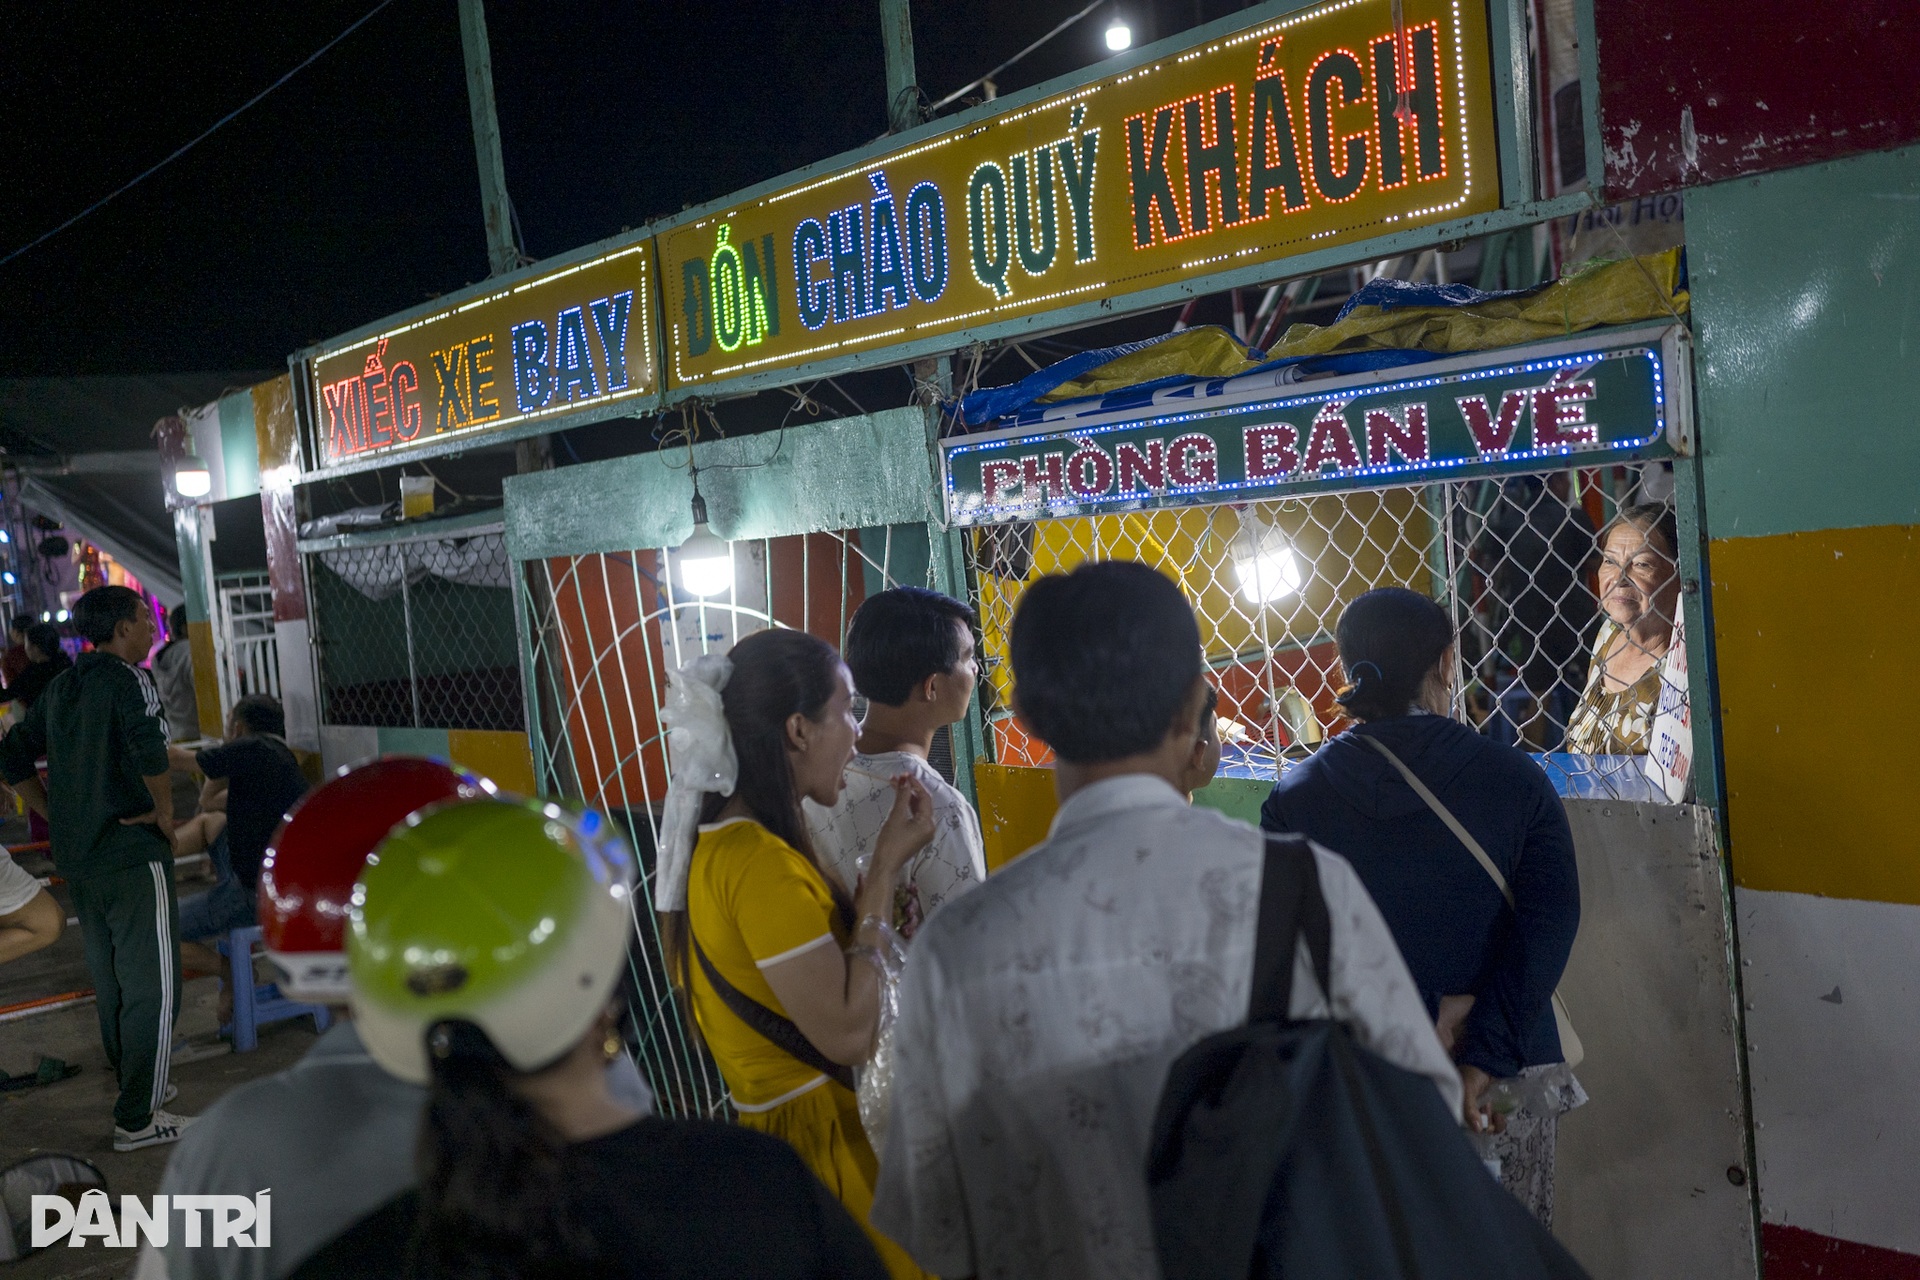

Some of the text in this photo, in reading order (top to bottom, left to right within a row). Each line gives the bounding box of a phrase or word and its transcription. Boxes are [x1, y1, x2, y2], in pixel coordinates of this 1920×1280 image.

[681, 20, 1448, 358] ĐÓN CHÀO QUÝ KHÁCH
[322, 289, 633, 458] XIẾC XE BAY
[980, 358, 1599, 509] PHÒNG BÁN VÉ
